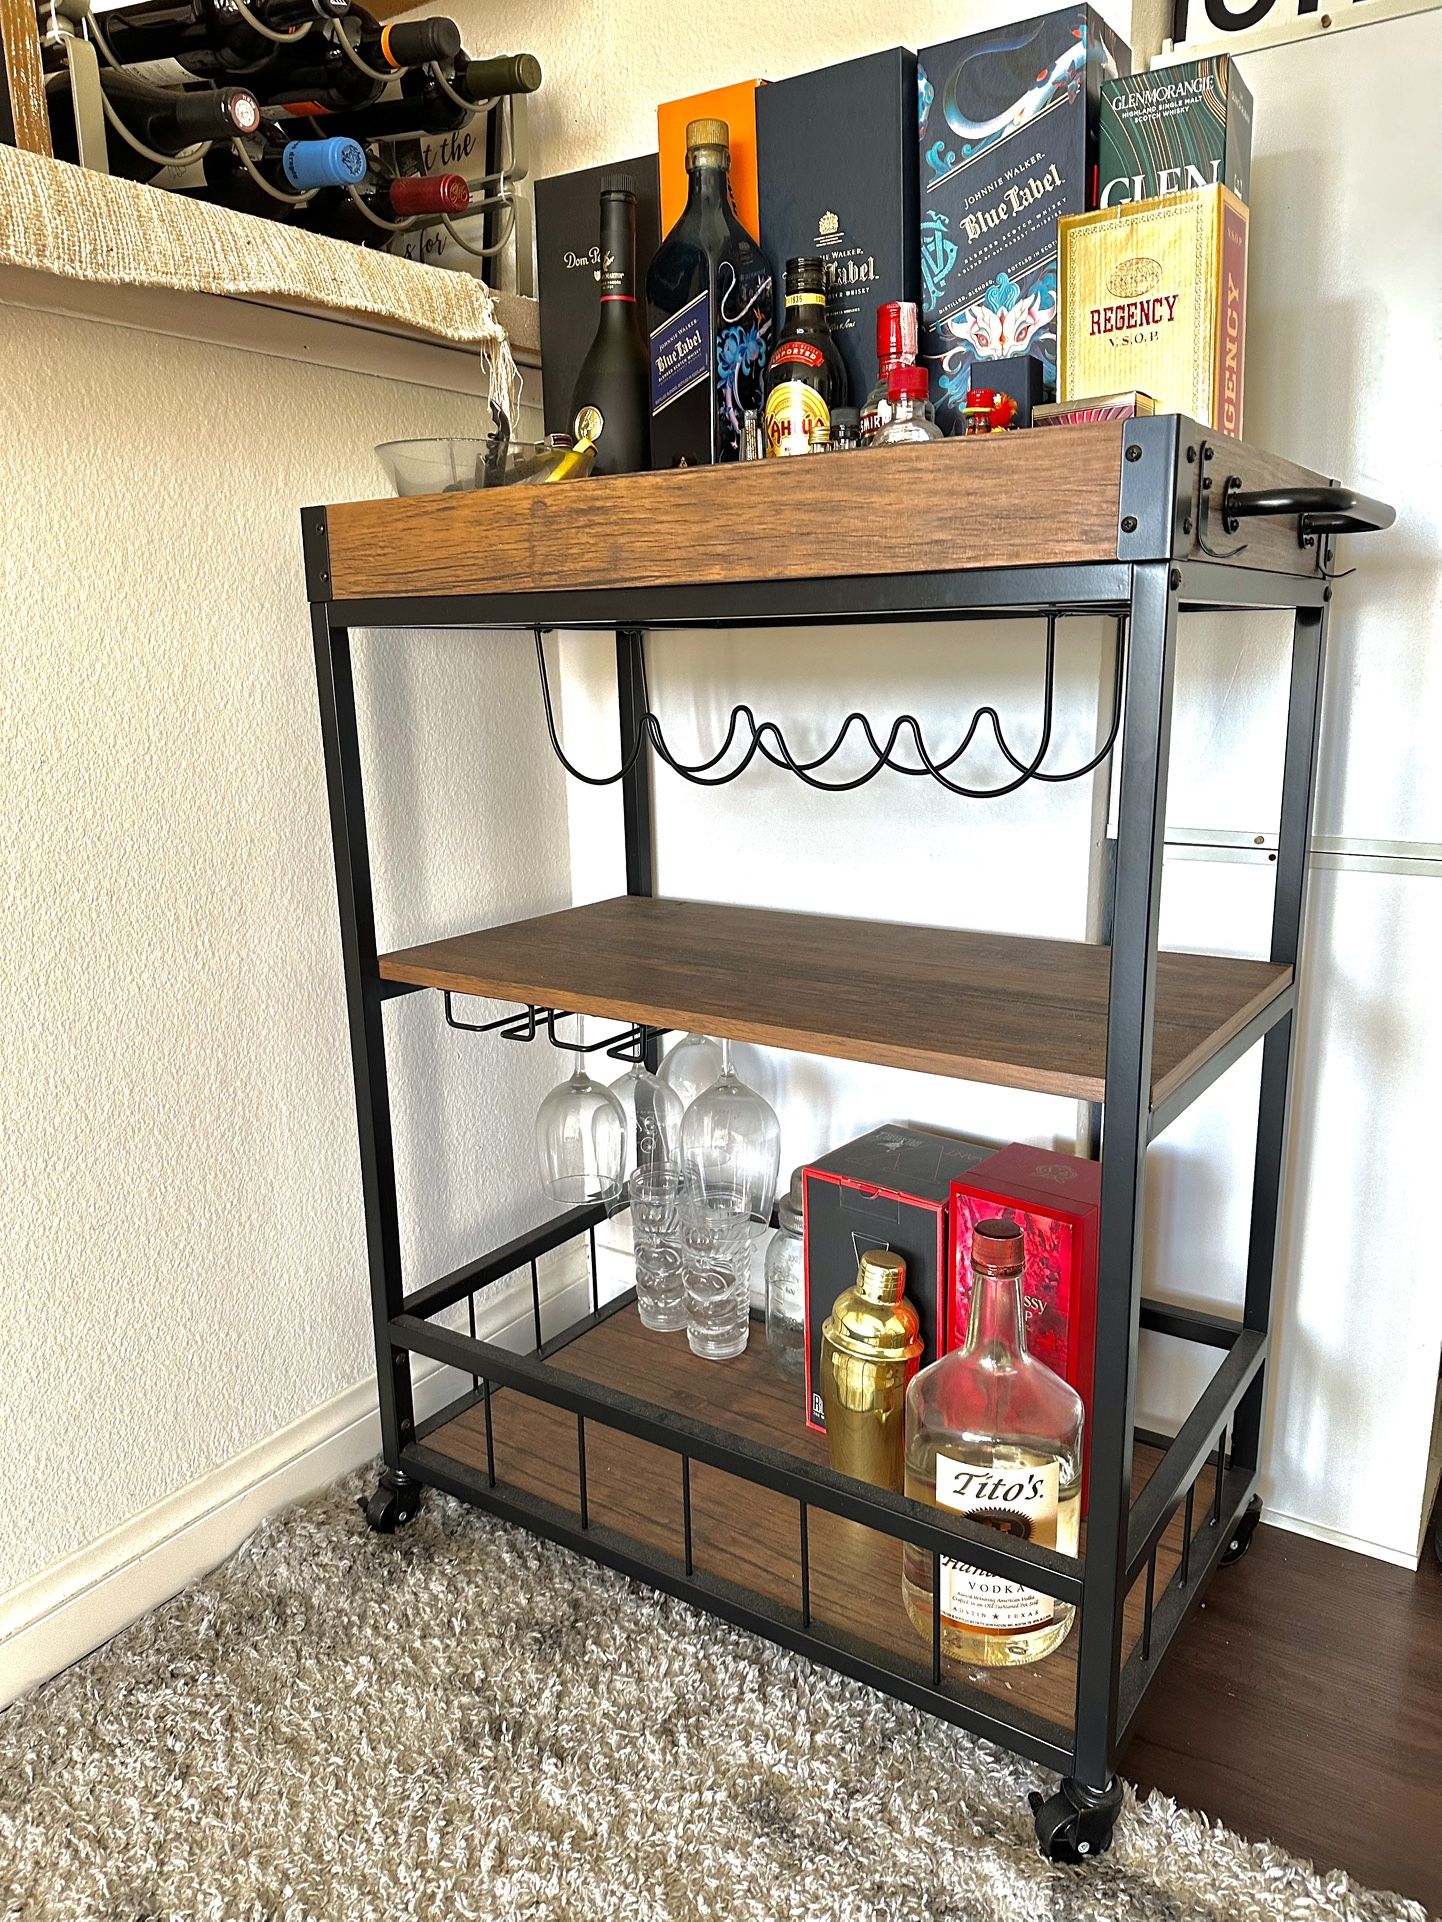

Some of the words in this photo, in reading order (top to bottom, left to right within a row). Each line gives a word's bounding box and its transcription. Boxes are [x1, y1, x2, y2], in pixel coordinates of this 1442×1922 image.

[1112, 74, 1214, 111] GLENMORANGIE
[1122, 105, 1157, 119] HIGHLAND
[1158, 100, 1183, 111] SINGLE
[1184, 95, 1203, 105] MALT
[1134, 112, 1161, 123] SCOTCH
[1162, 106, 1190, 117] WHISKY
[440, 130, 476, 166] the
[963, 177, 1004, 211] JOHNNIE
[1035, 196, 1067, 219] WHISKY
[959, 202, 1009, 245] Blue
[563, 251, 589, 269] Dom
[1089, 294, 1179, 336] REGENCY
[655, 351, 677, 375] Blue
[674, 329, 702, 359] Label
[968, 1581, 1025, 1594] VODKA
[952, 1606, 987, 1618] AUSTIN
[1007, 1609, 1040, 1619] TEXAS
